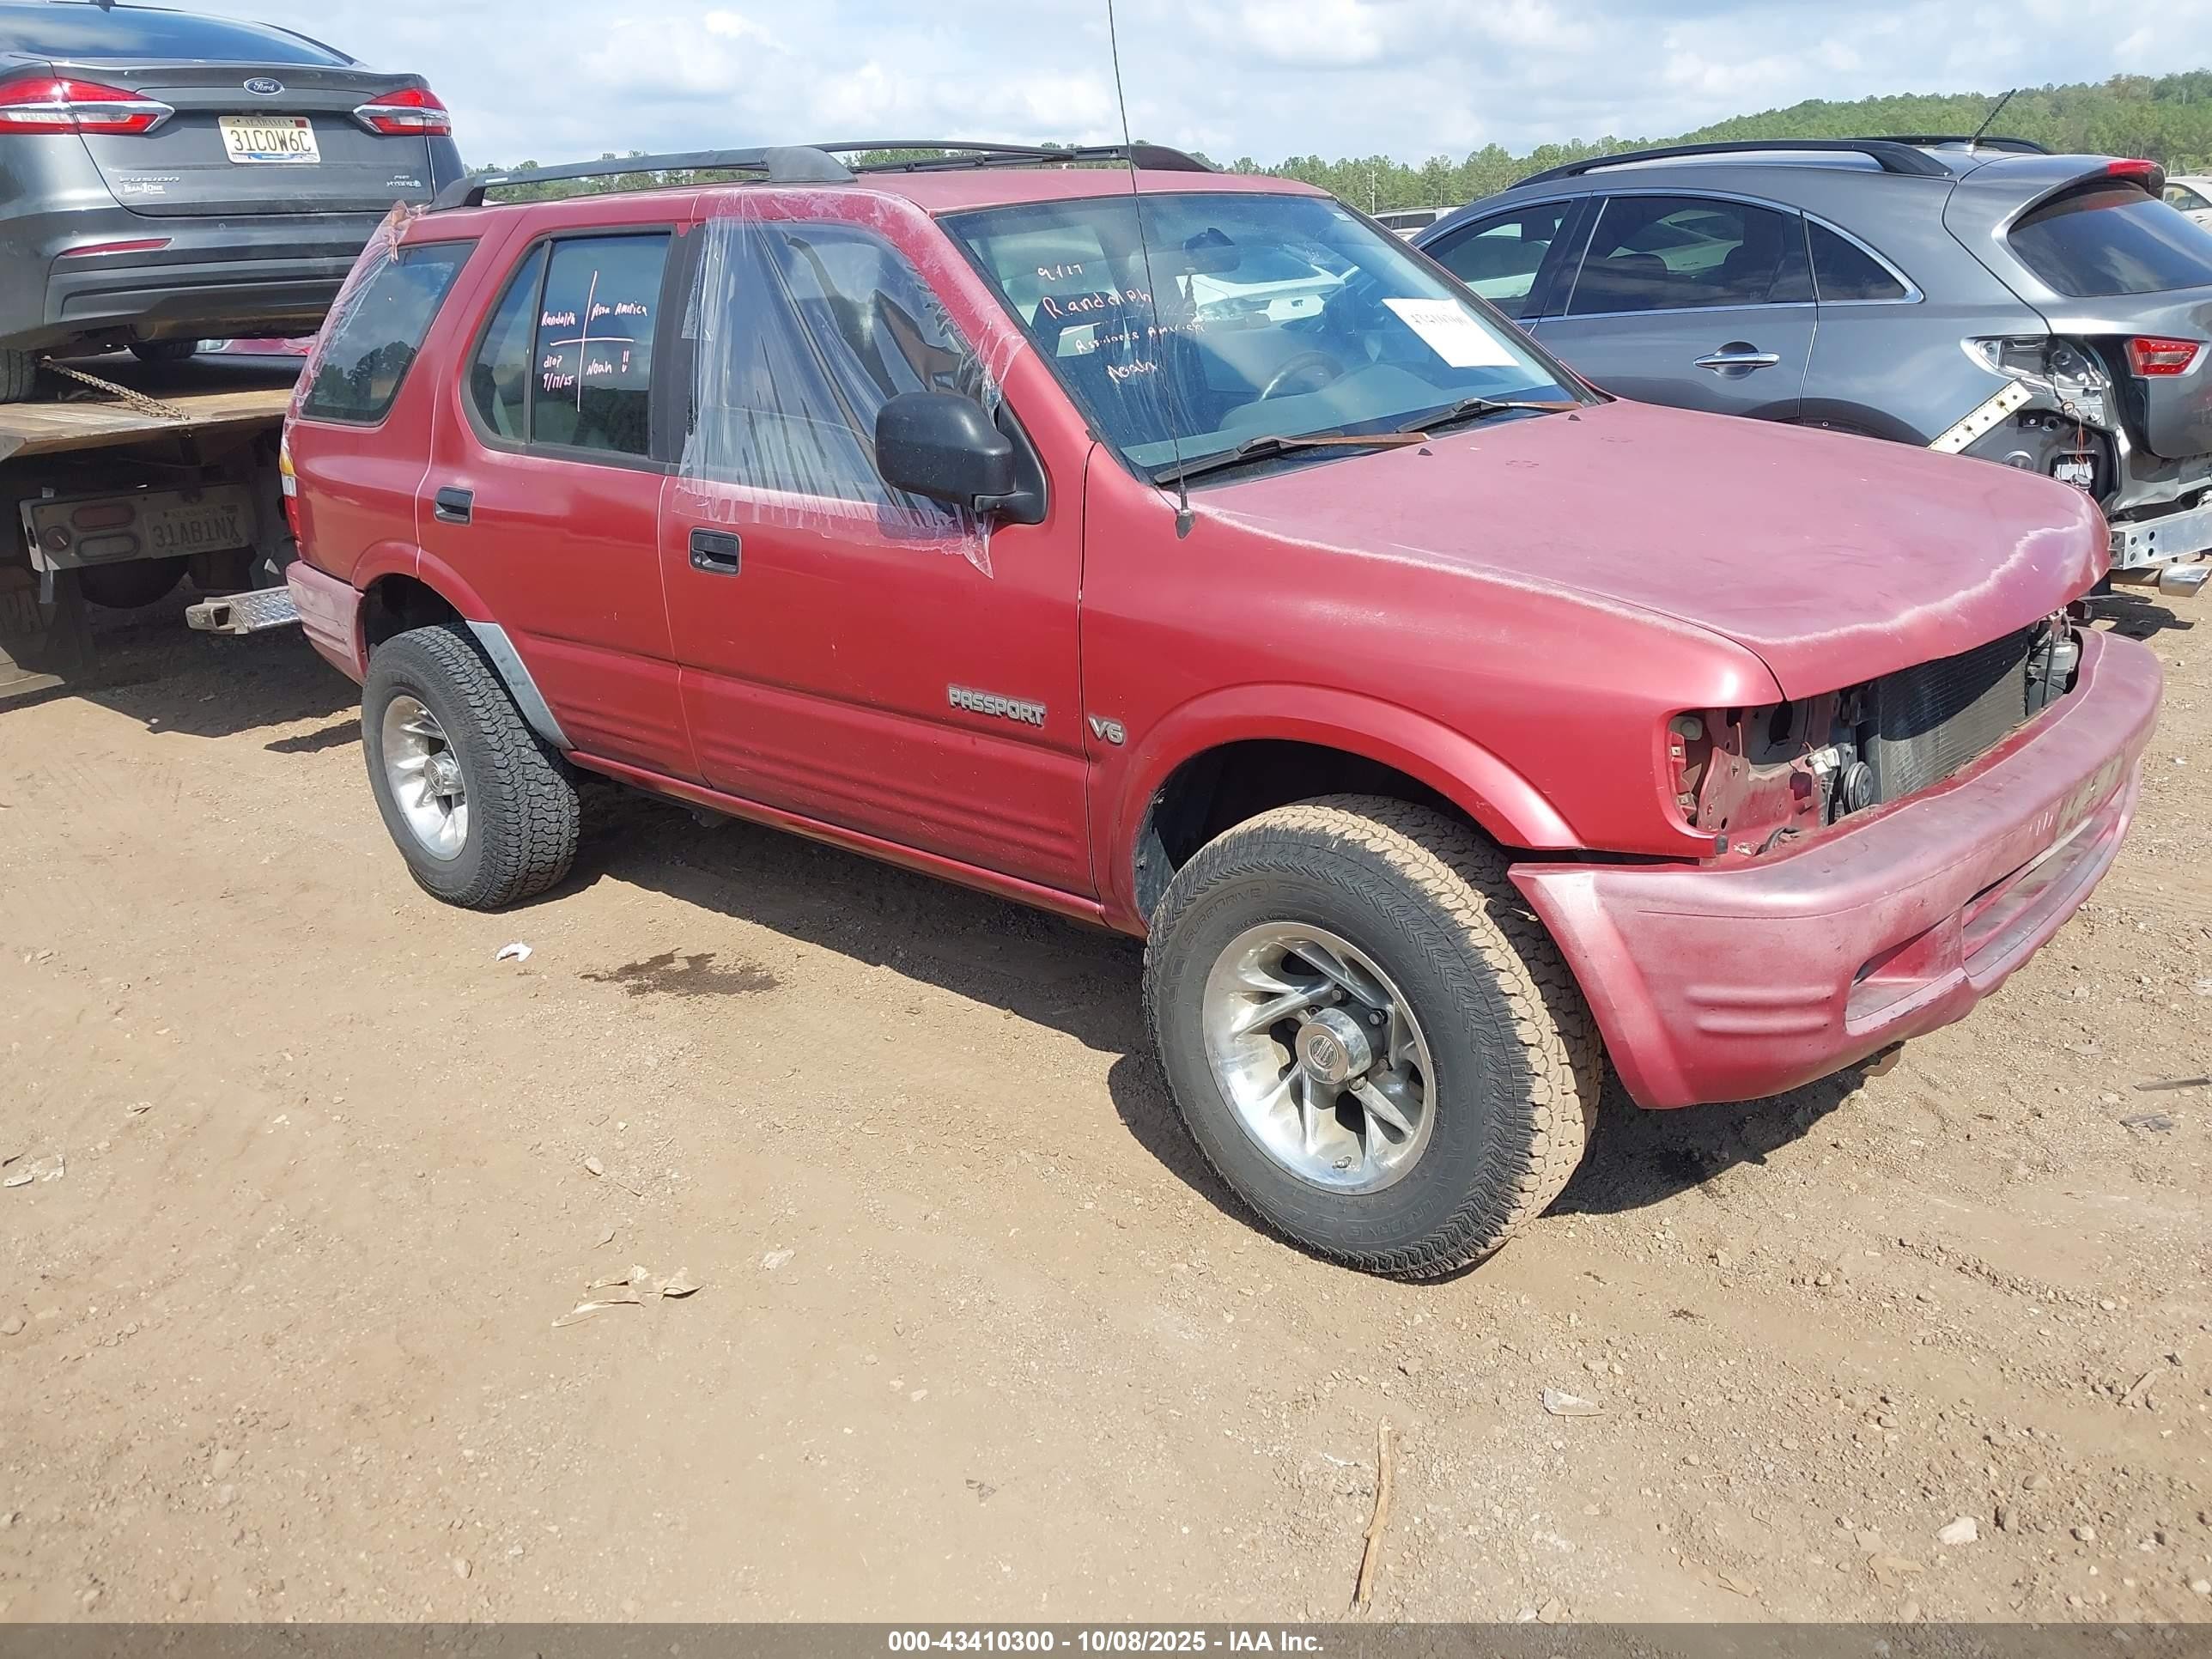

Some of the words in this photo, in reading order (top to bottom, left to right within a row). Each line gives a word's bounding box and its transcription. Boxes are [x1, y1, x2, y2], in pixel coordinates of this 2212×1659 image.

[252, 81, 276, 92] Ford
[586, 358, 612, 375] Noah
[948, 687, 1046, 726] PASSPORT
[1088, 716, 1125, 744] V6
